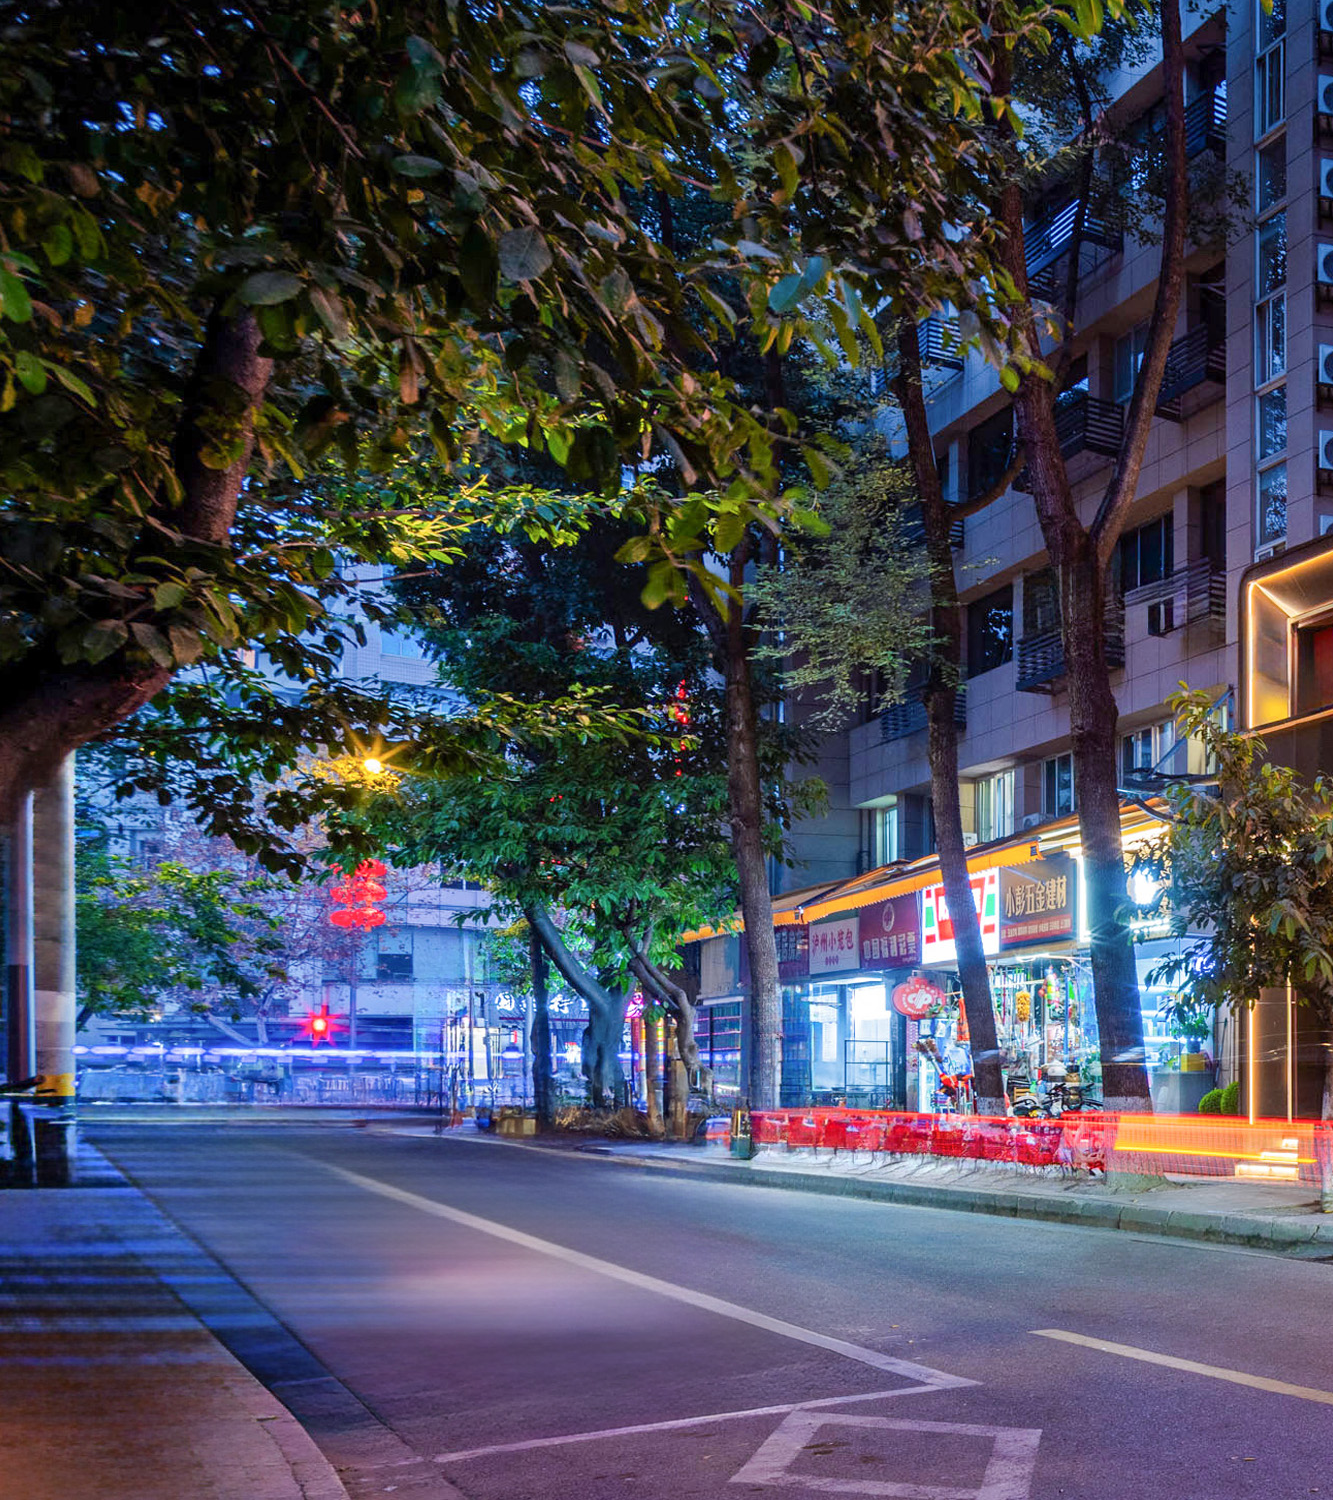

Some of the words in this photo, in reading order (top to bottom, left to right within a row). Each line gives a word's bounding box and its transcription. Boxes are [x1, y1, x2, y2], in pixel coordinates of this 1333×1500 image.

[1005, 875, 1067, 918] 小彭五金建材
